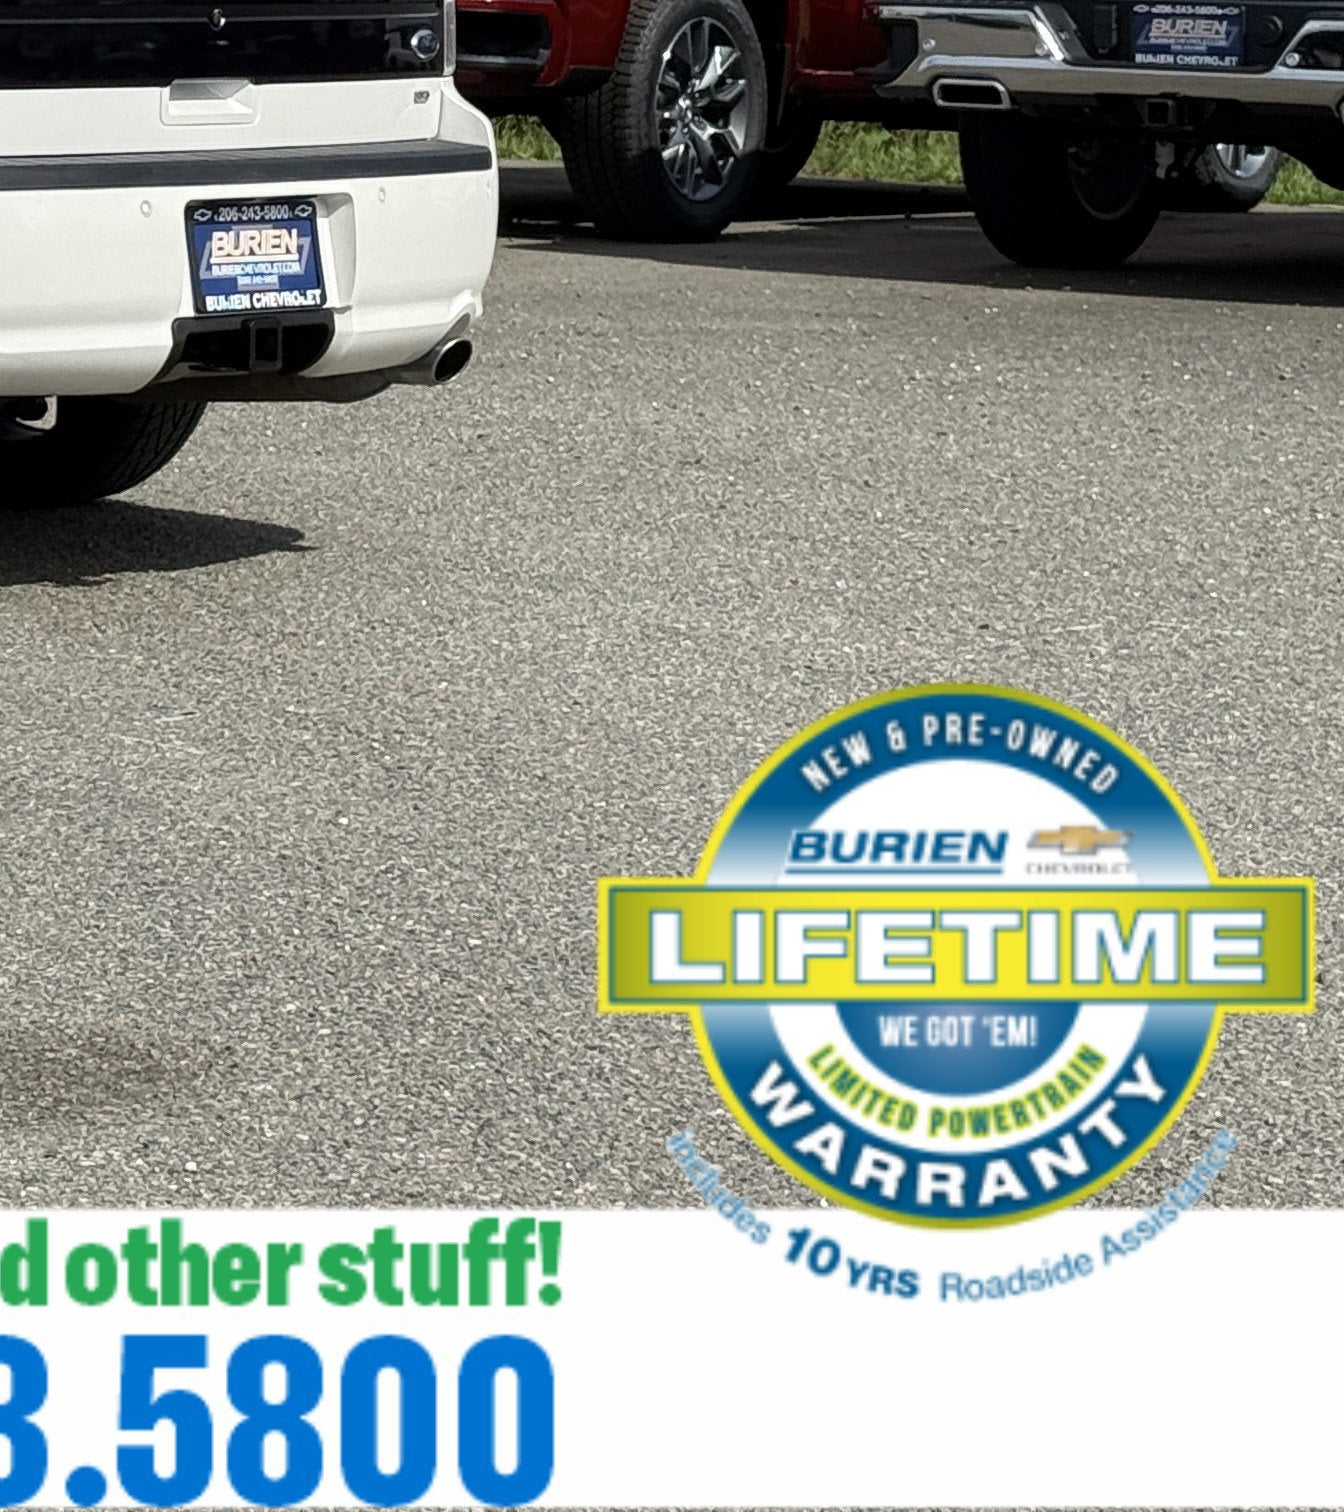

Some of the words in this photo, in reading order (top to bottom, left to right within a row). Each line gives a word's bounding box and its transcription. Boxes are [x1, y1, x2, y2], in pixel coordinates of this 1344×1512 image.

[1151, 18, 1228, 35] BURIEN
[218, 204, 290, 222] 206-243-5800
[211, 228, 299, 257] BURIEN
